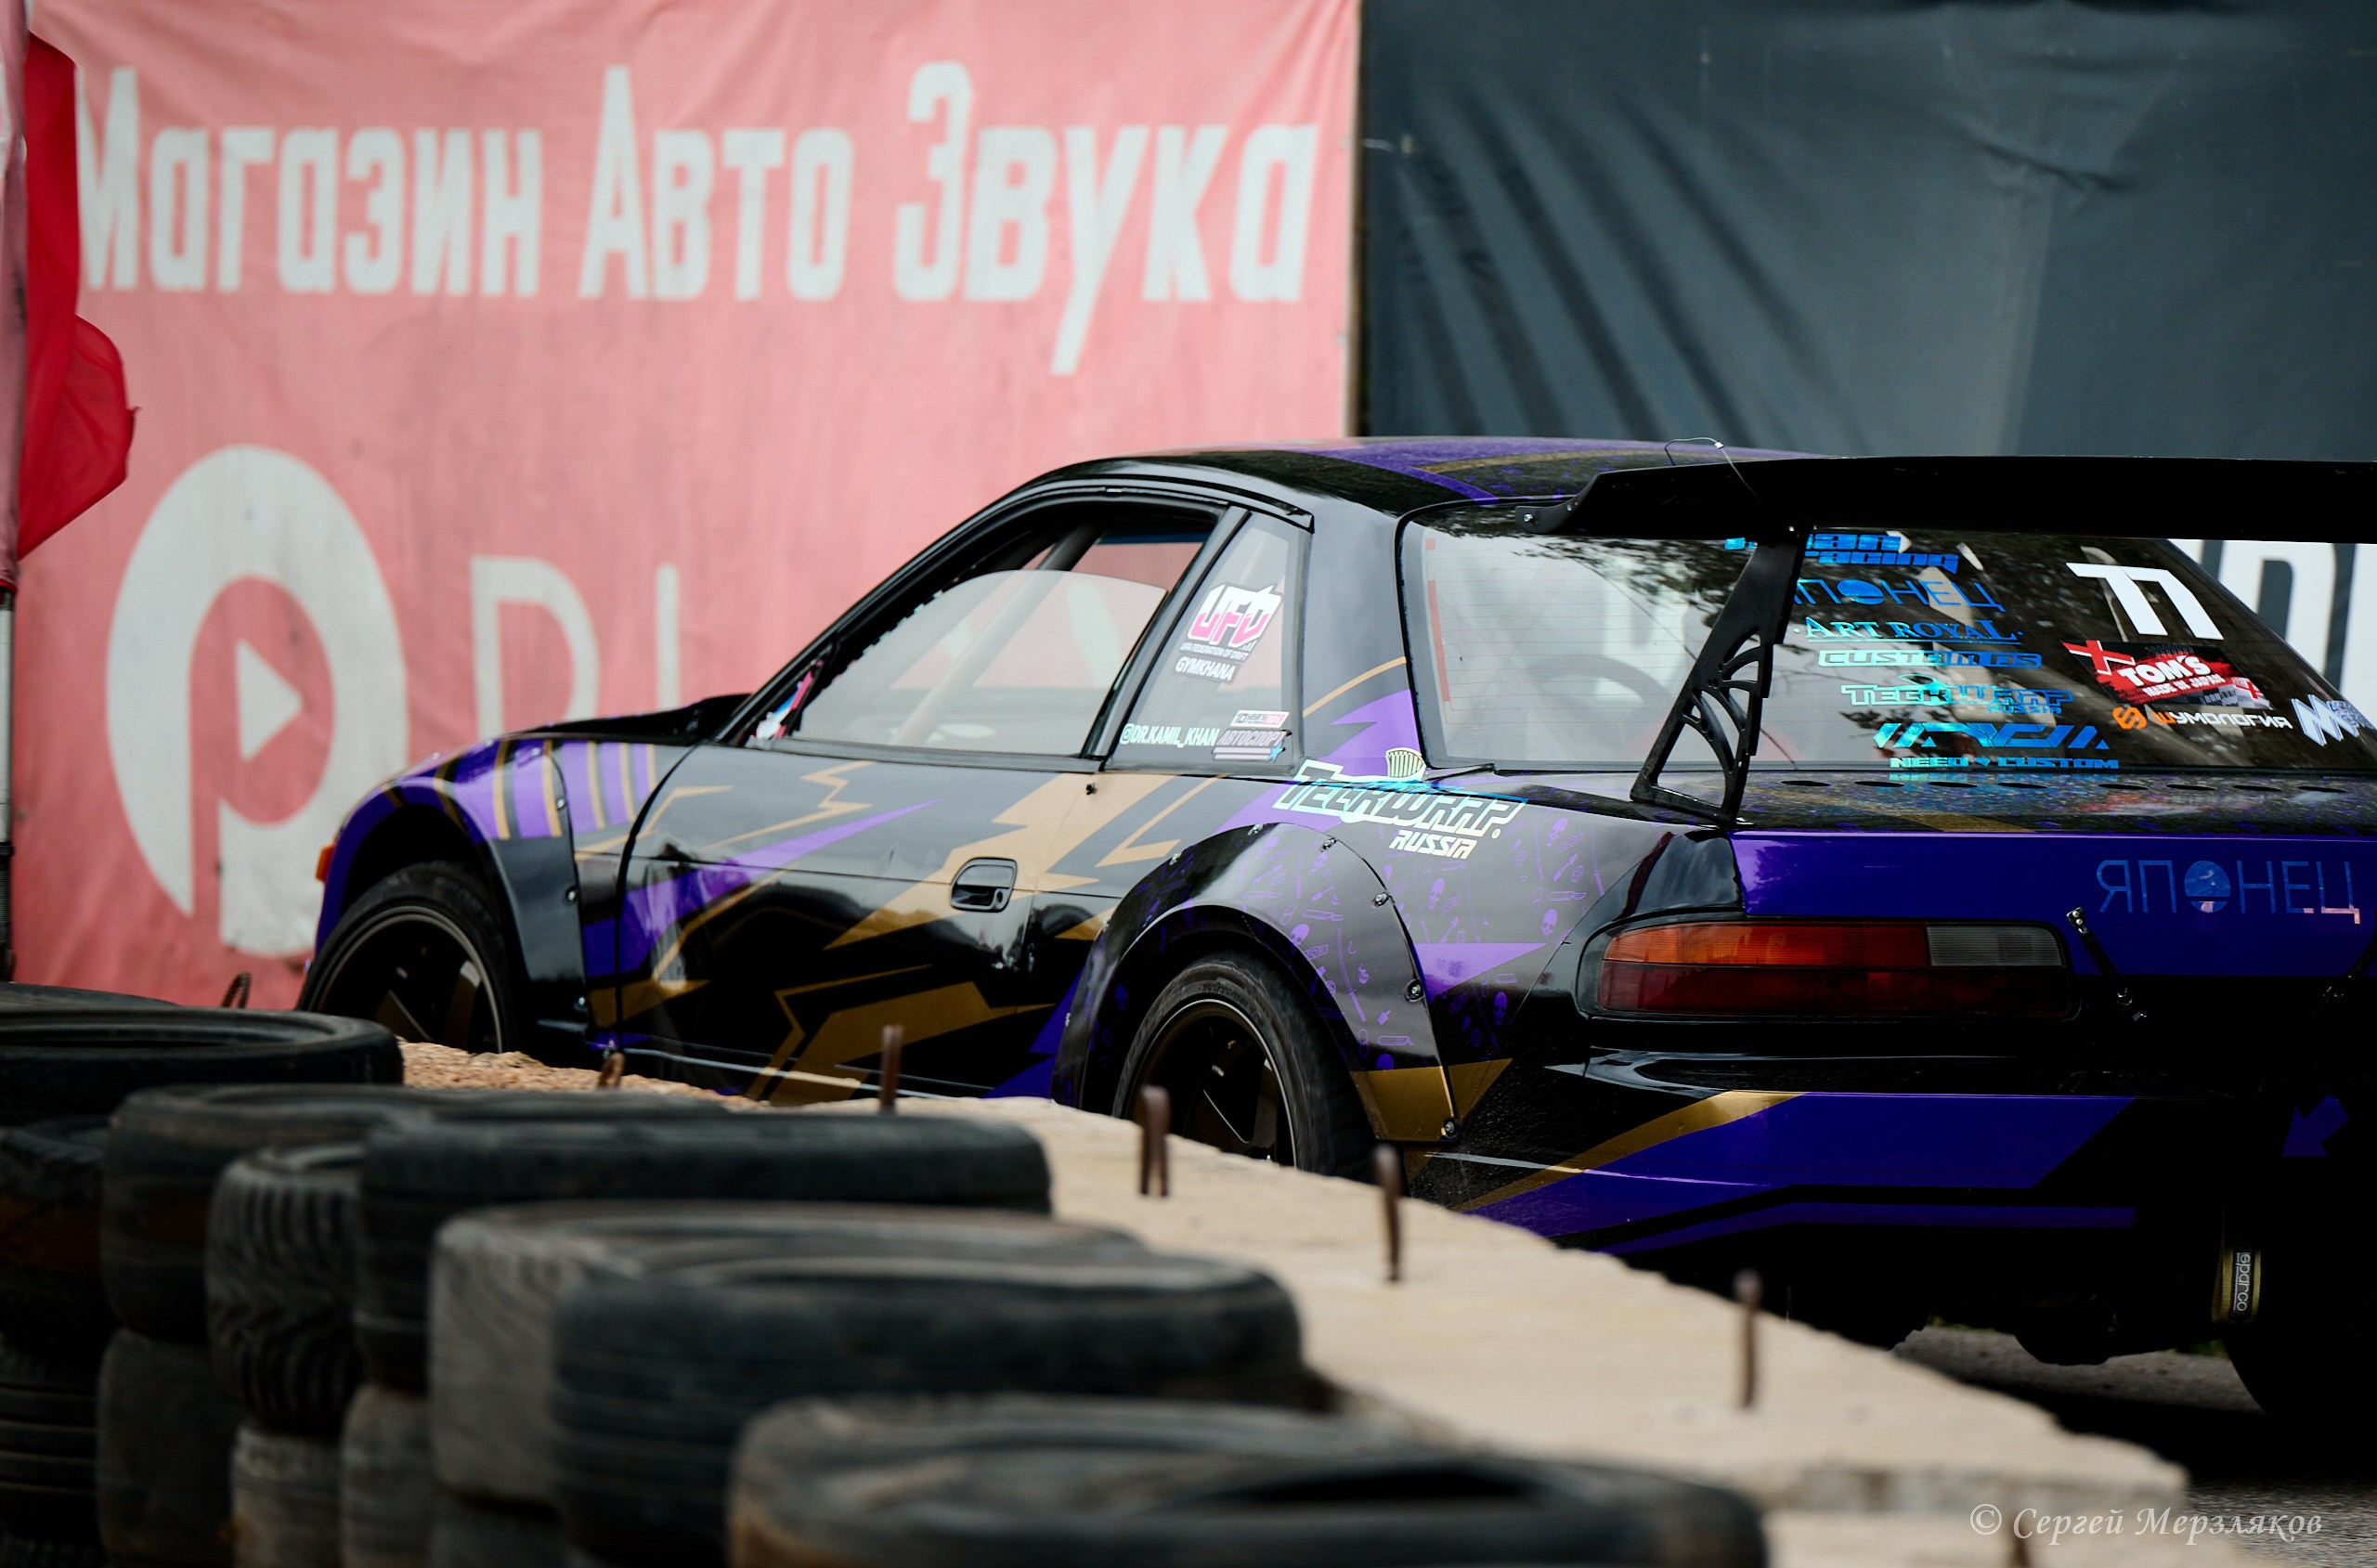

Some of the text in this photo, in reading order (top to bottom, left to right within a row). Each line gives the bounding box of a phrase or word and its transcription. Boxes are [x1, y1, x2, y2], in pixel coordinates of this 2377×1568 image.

[75, 60, 1318, 376] Магазин Авто Звука
[1794, 577, 2006, 613] ПОНЕЦ
[1176, 656, 1236, 680] GYMKHANA
[2117, 655, 2211, 686] TOM'S
[1216, 730, 1287, 746] АВТОСПОРТ
[1890, 758, 2119, 769] NEED CUSTOM
[1388, 829, 1478, 859] RUSSIA
[2097, 860, 2360, 924] ЯПОНЕЦ
[2235, 1253, 2251, 1311] sparco
